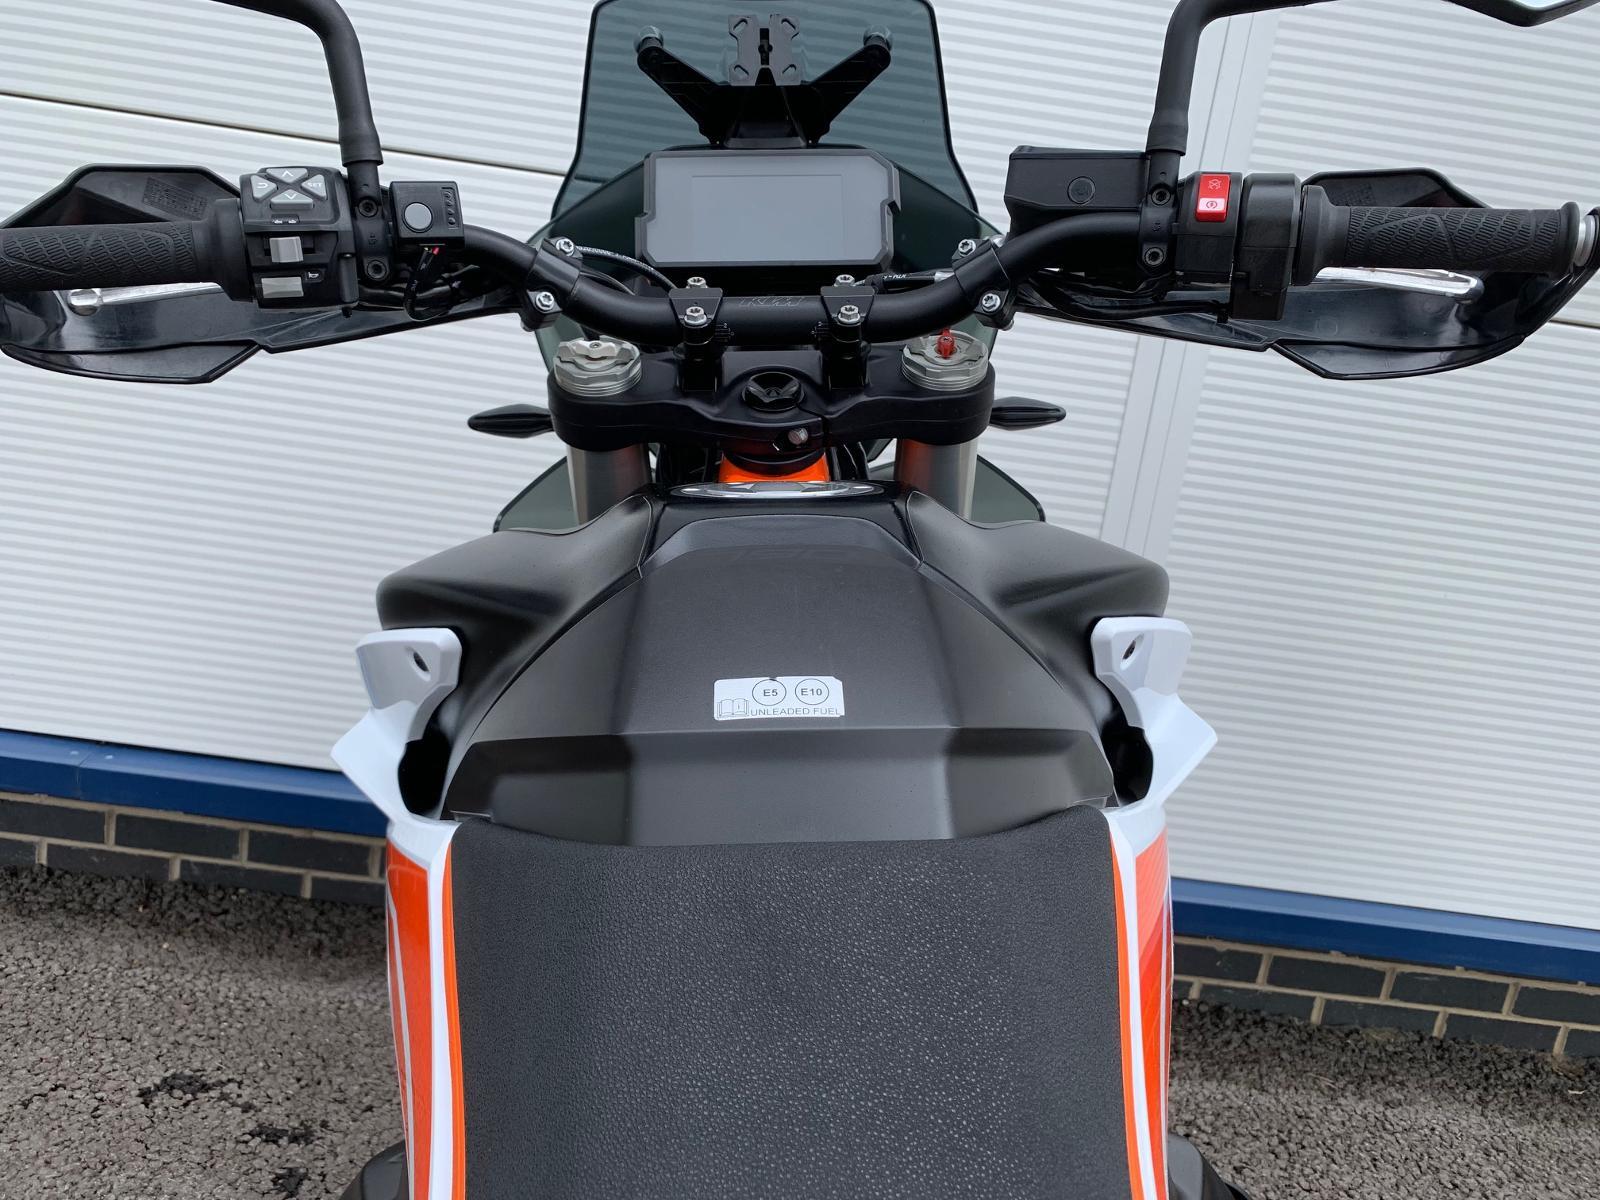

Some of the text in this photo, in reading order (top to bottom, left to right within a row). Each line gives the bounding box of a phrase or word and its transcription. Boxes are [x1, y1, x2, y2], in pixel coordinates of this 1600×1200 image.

[763, 688, 778, 697] E5
[800, 688, 823, 696] E10
[750, 707, 840, 717] UNLEADED FUEL
